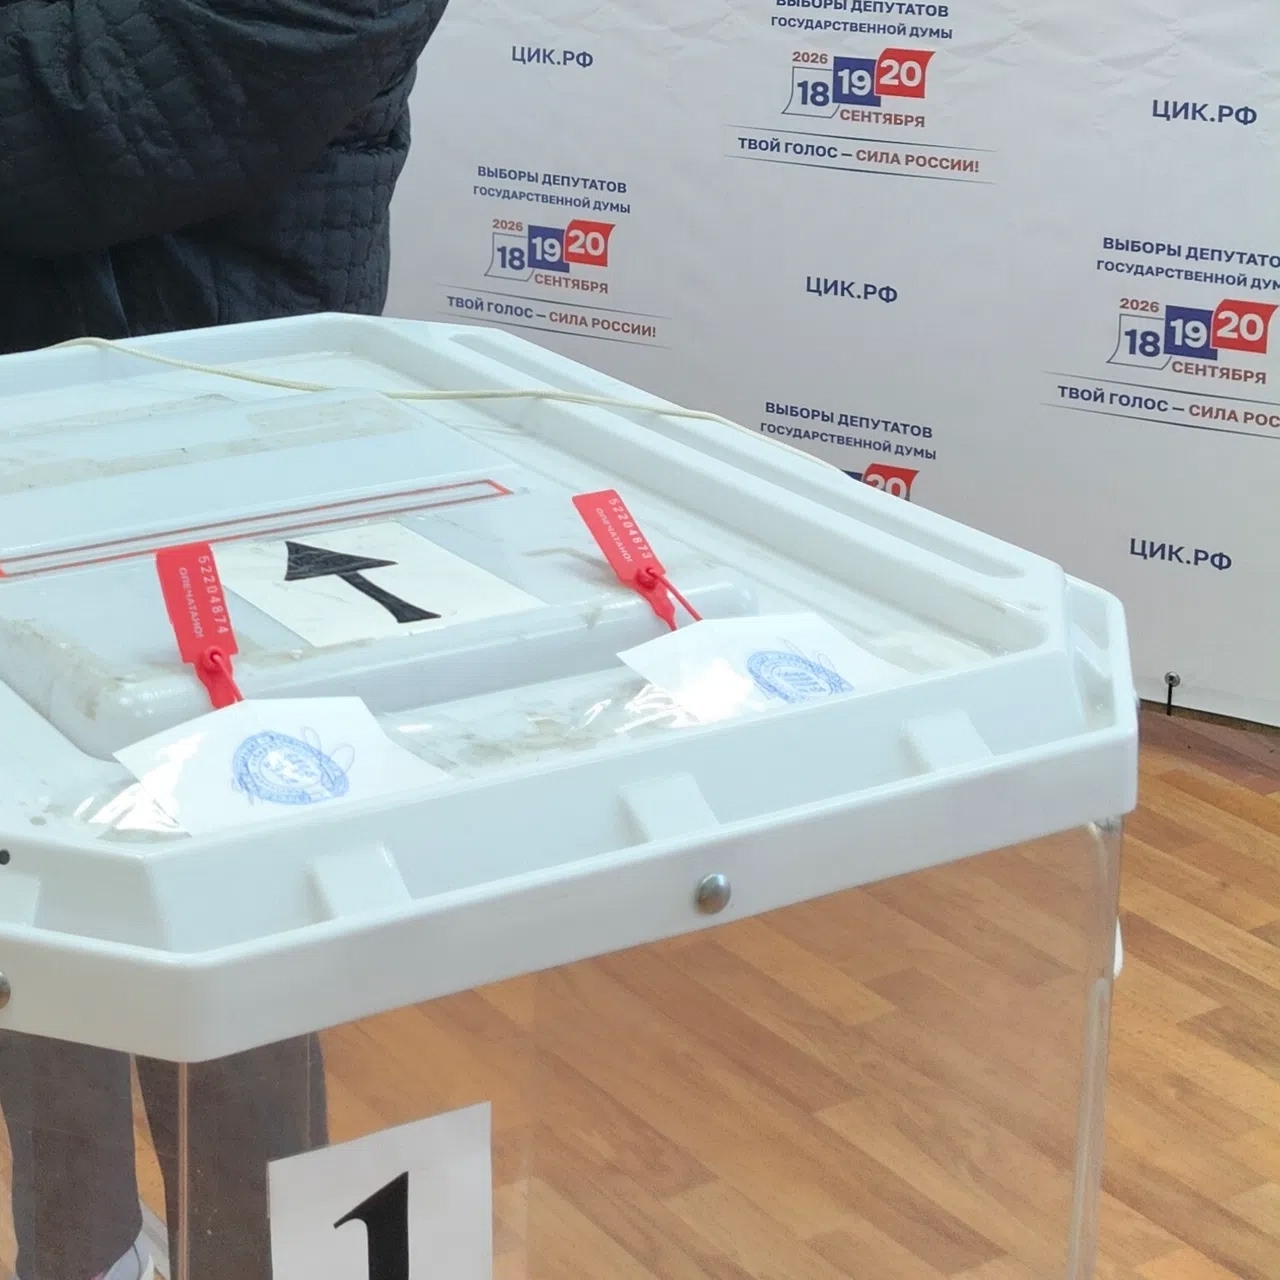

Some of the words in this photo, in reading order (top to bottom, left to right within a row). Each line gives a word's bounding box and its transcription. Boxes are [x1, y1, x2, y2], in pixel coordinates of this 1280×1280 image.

[851, 0, 948, 17] ДЕПУТАТОВ
[772, 17, 906, 35] ГОСУДАРСТВЕННОЙ
[909, 27, 952, 39] ДУМЫ
[512, 46, 593, 68] ЦИК.РФ
[792, 52, 828, 64] 2026
[797, 81, 829, 106] 18
[838, 68, 871, 96] 19
[880, 58, 922, 88] 20
[840, 109, 925, 127] СЕНТЯБРЯ
[1153, 100, 1257, 125] ЦИК.РФ
[738, 138, 780, 152] ТВОЙ
[785, 142, 837, 158] ГОЛОС
[856, 150, 901, 164] СИЛА
[905, 154, 978, 172] РОССИИ!
[478, 166, 538, 183] ВЫБОРЫ
[542, 174, 626, 193] ДЕПУТАТОВ
[474, 186, 590, 208] ГОСУДАРСТВЕННОЙ
[593, 201, 630, 213] ДУМЫ
[493, 219, 523, 231] 2026
[497, 246, 525, 270] 18
[532, 236, 561, 262] 19
[568, 229, 604, 256] 20
[1104, 237, 1181, 257] ВЫБОРЫ
[535, 274, 608, 294] СЕНТЯБРЯ
[1097, 260, 1247, 286] ГОСУДАРСТВЕННОЙ
[807, 276, 897, 303] ЦИК.РФ
[447, 296, 483, 311] ТВОЙ
[488, 302, 533, 318] ГОЛОС
[549, 312, 588, 327] СИЛА
[592, 318, 655, 337] РОССИИ!
[1120, 298, 1159, 312] 2026
[1125, 329, 1160, 357] 18
[1171, 319, 1207, 348] 19
[1217, 311, 1264, 341] 20
[1172, 361, 1266, 384] СЕНТЯБРЯ
[1058, 386, 1104, 403] ТВОЙ
[1110, 393, 1168, 411] ГОЛОС
[1189, 405, 1238, 422] СИЛА
[766, 402, 833, 423] ВЫБОРЫ
[838, 414, 932, 438] ДЕПУТАТОВ
[760, 422, 892, 452] ГОСУДАРСТВЕННОЙ
[895, 445, 936, 460] ДУМЫ
[1131, 538, 1231, 570] ЦИК.РФ
[333, 1171, 409, 1280] 1
